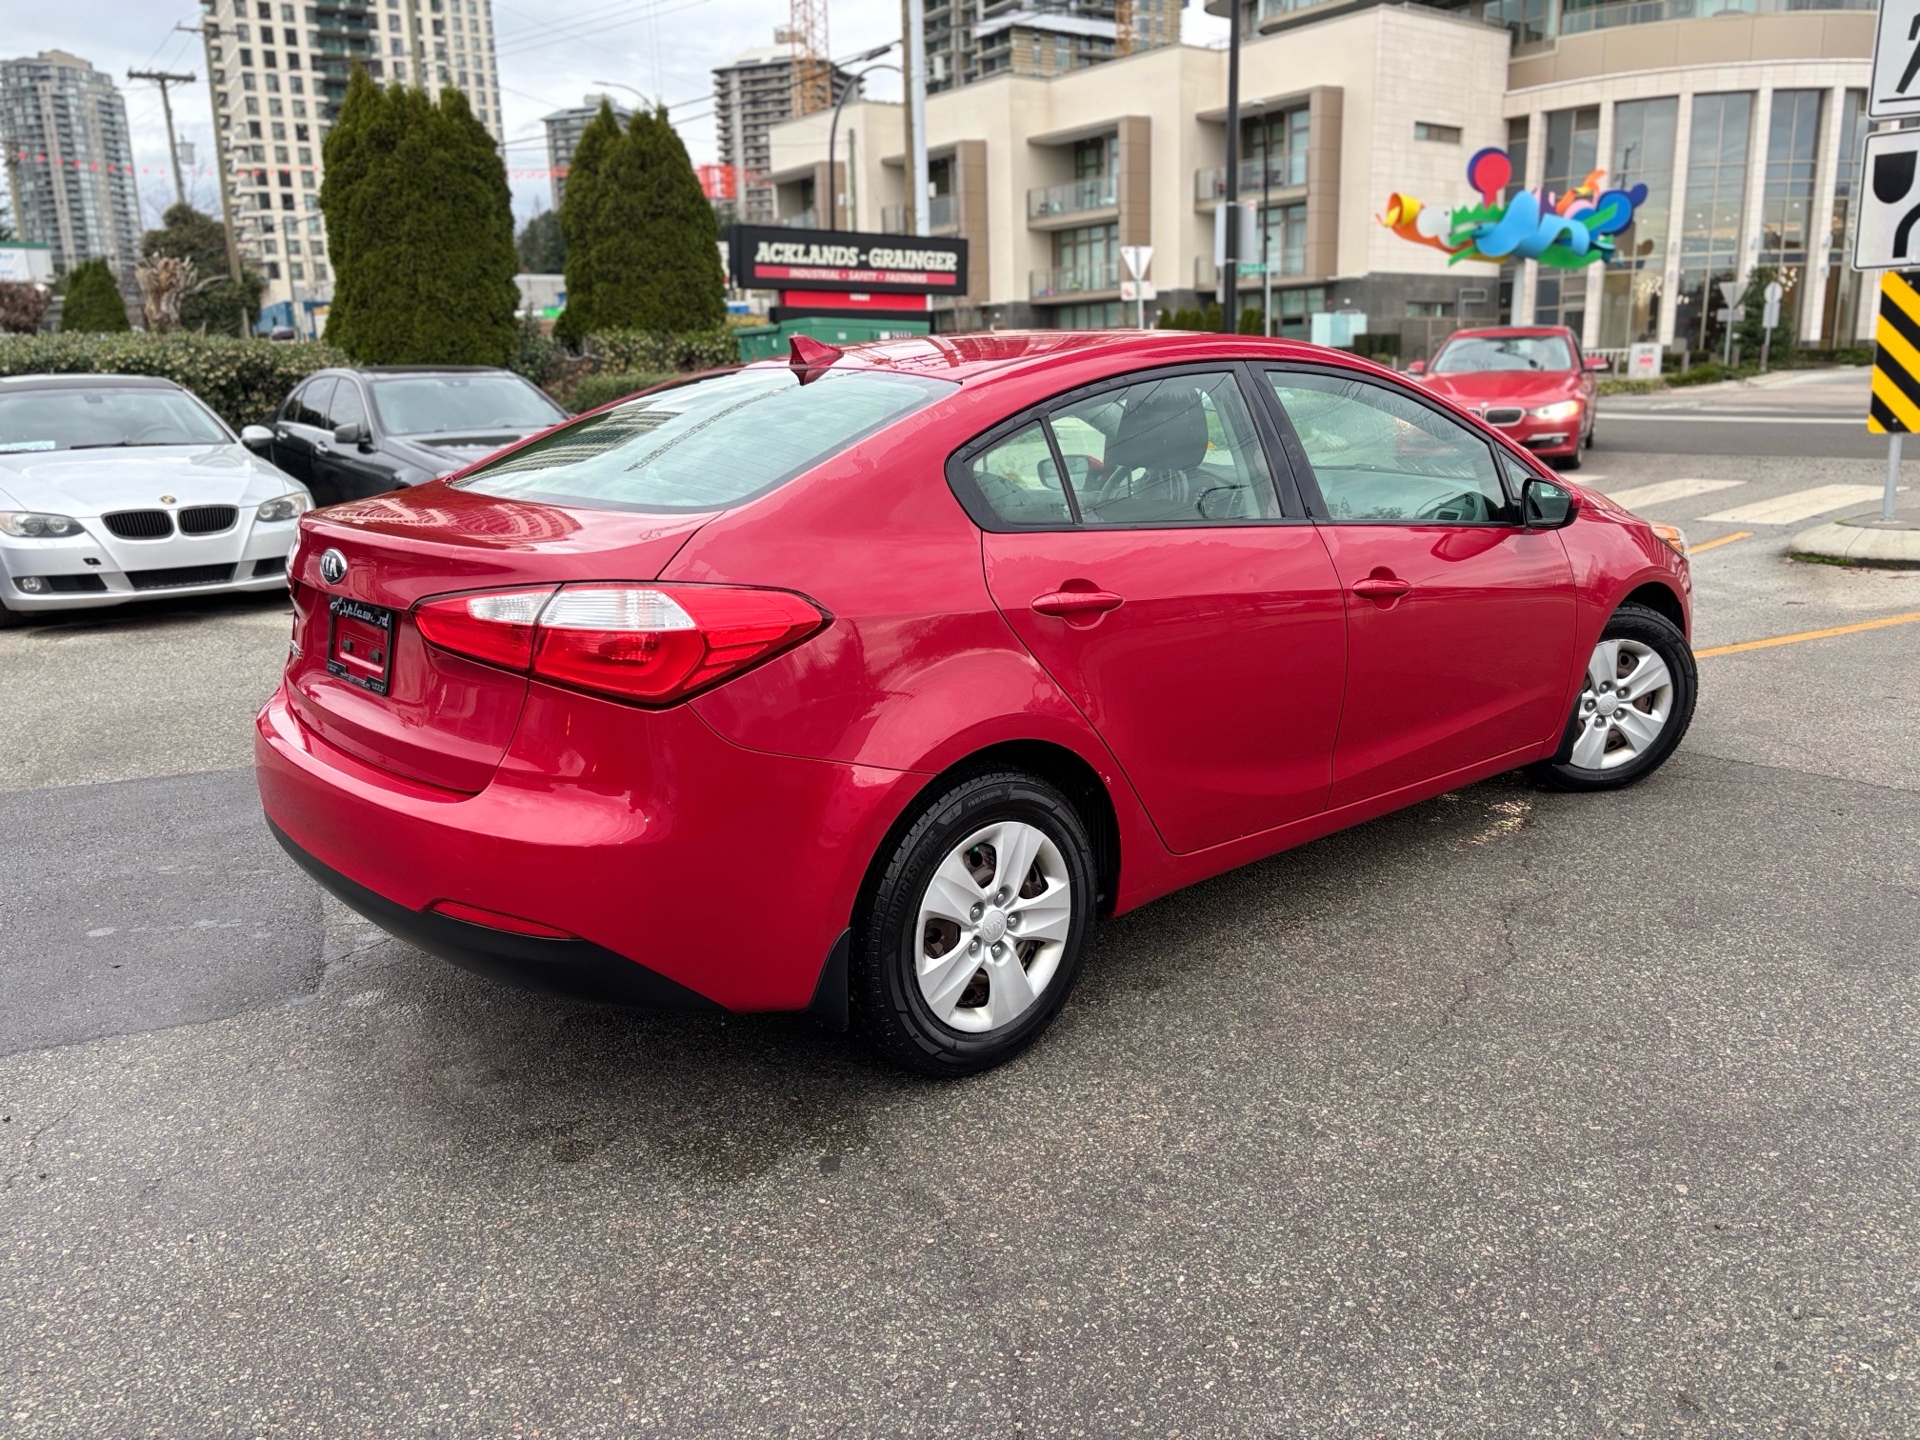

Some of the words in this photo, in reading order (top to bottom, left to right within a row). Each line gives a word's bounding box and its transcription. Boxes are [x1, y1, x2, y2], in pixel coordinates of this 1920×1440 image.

[789, 267, 840, 281] INDUSTRIAL
[847, 270, 877, 282] SAFETY
[884, 272, 928, 285] FASTENERS
[321, 555, 338, 578] KIA
